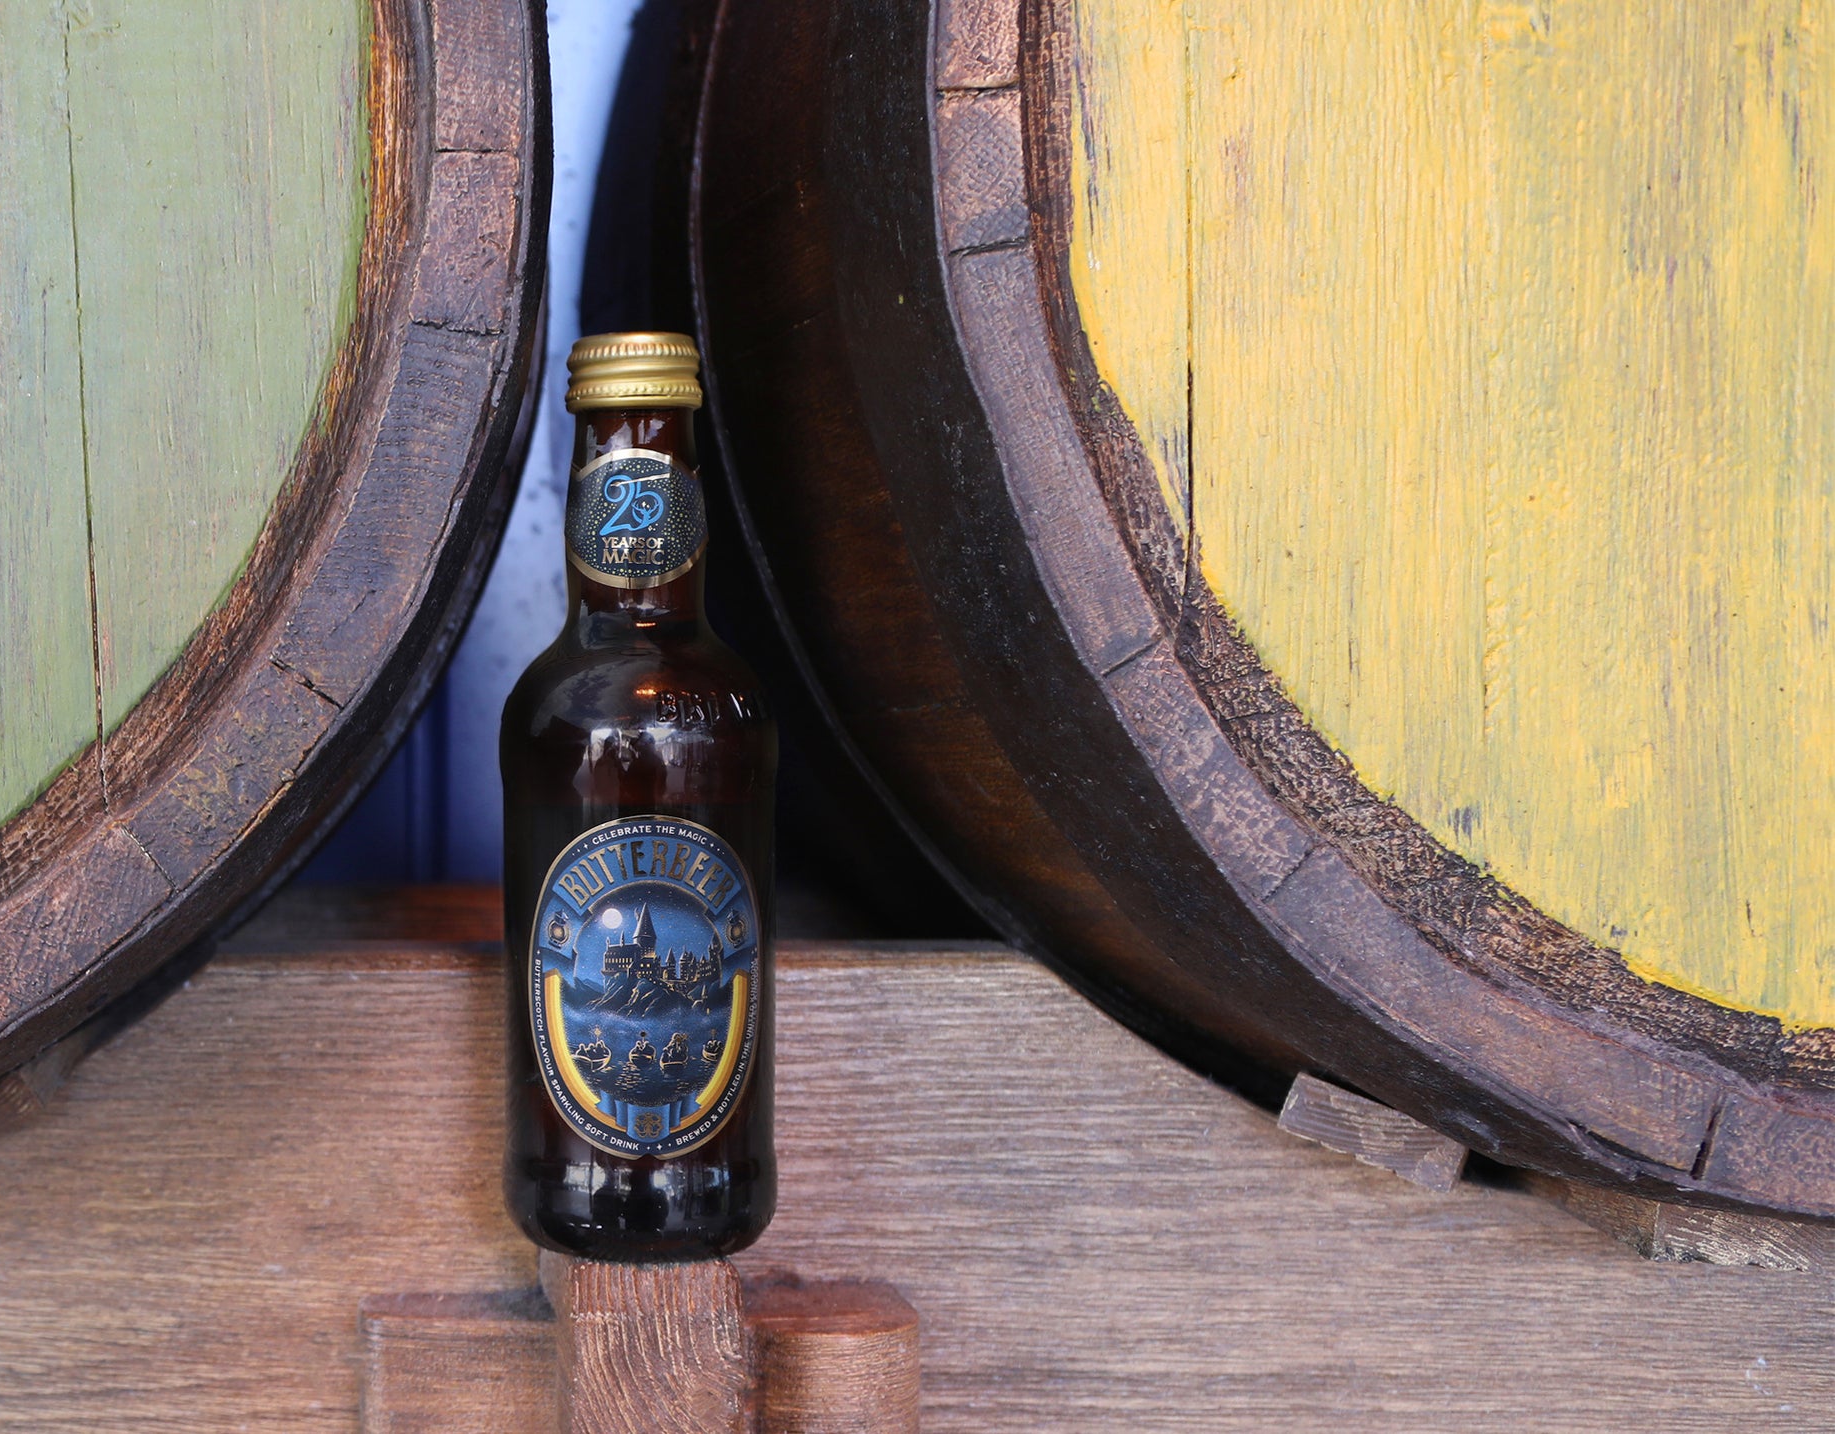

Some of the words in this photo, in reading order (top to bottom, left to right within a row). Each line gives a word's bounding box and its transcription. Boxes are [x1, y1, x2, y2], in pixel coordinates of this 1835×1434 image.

[599, 474, 664, 536] 25
[601, 536, 645, 549] YEARS
[646, 537, 665, 549] OF
[601, 548, 665, 565] MAGIC
[591, 825, 652, 845] CELEBRATE
[655, 825, 676, 835] THE
[678, 828, 708, 845] MAGIC
[558, 839, 736, 907] BUTTERBEER
[534, 959, 544, 1031] BUTTERSCOTCH
[539, 1035, 554, 1076] FLAVOUR
[551, 1079, 585, 1125] SPARKLING
[584, 1123, 608, 1140] SOFT
[609, 1137, 640, 1151] DRINK
[740, 1041, 751, 1060] THE
[737, 1062, 745, 1072] IN
[717, 1073, 741, 1114] BOTTLED
[710, 1113, 719, 1122] &
[675, 1120, 711, 1146] BREWED
